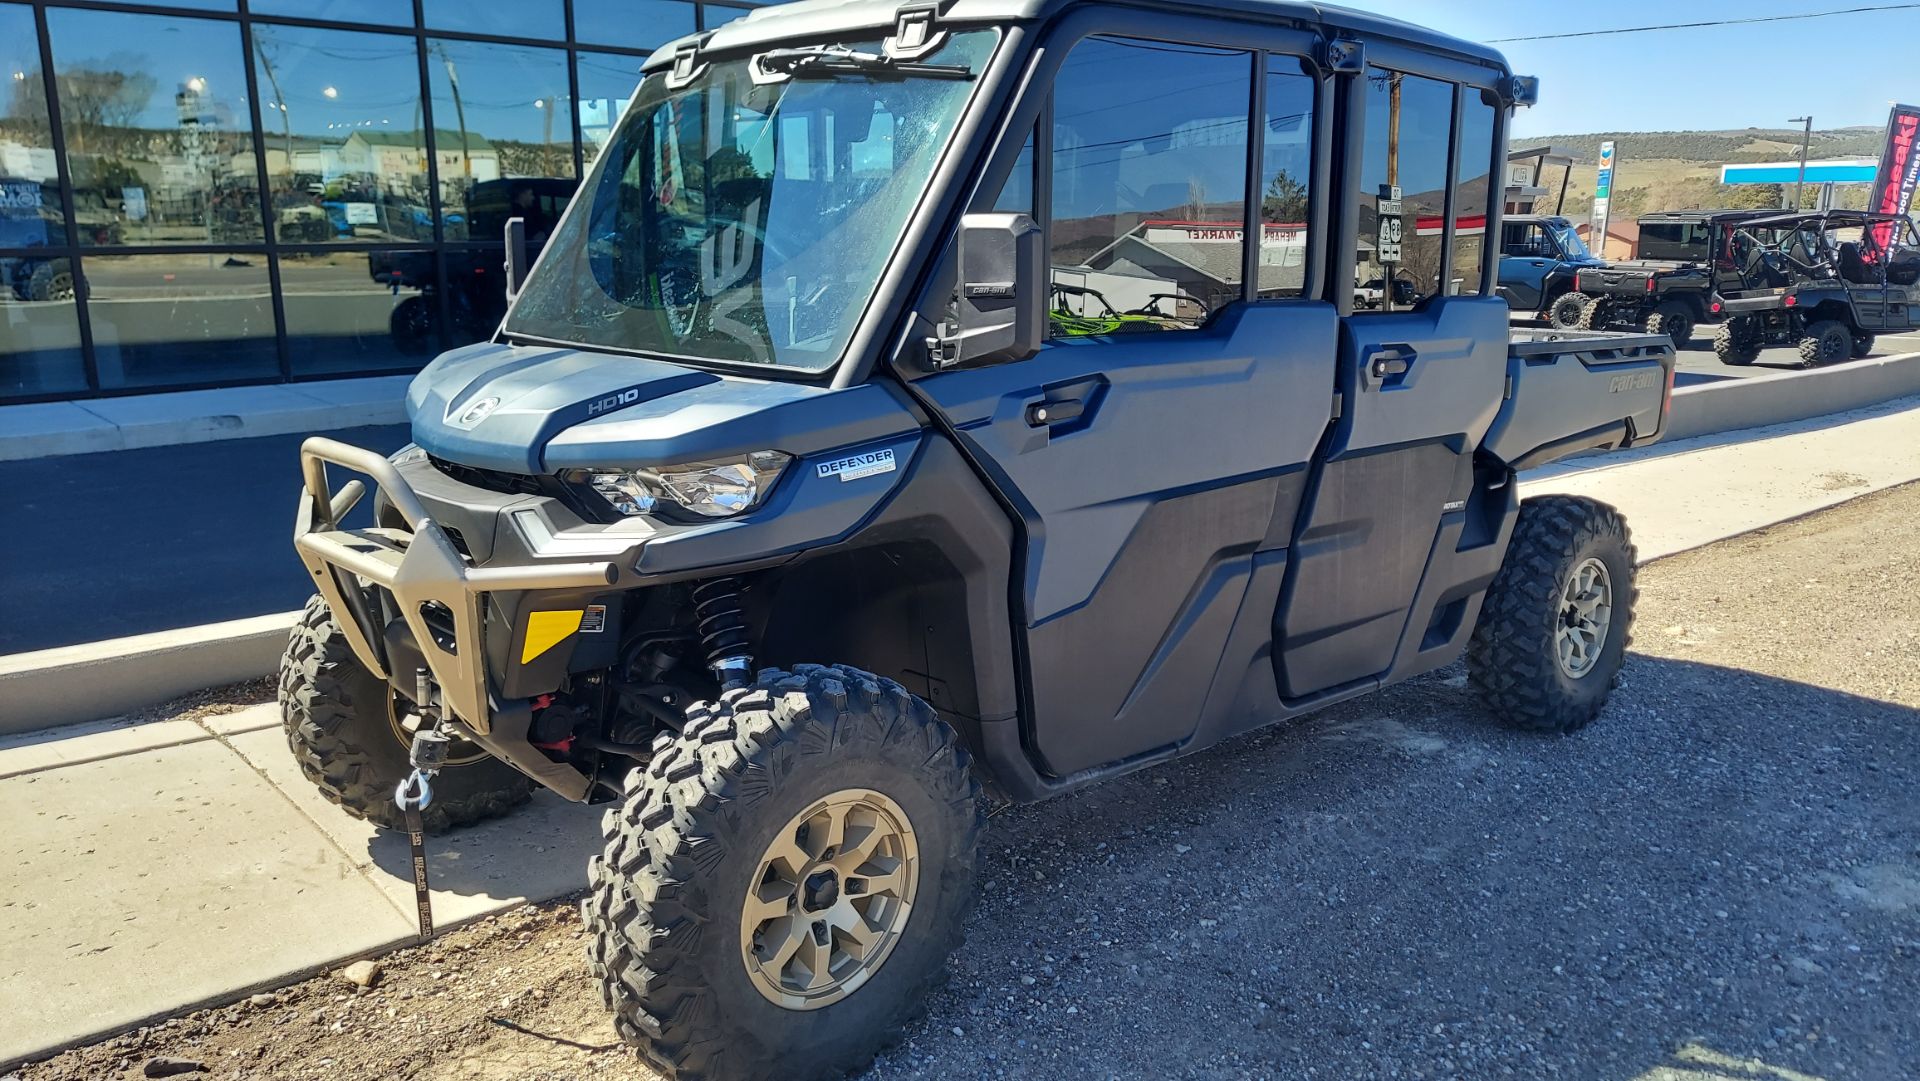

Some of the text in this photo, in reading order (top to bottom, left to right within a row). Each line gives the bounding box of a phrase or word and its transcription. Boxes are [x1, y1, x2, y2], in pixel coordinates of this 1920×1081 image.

[1609, 372, 1657, 393] can-am
[588, 389, 639, 415] HD10
[820, 450, 893, 474] DEFENDER
